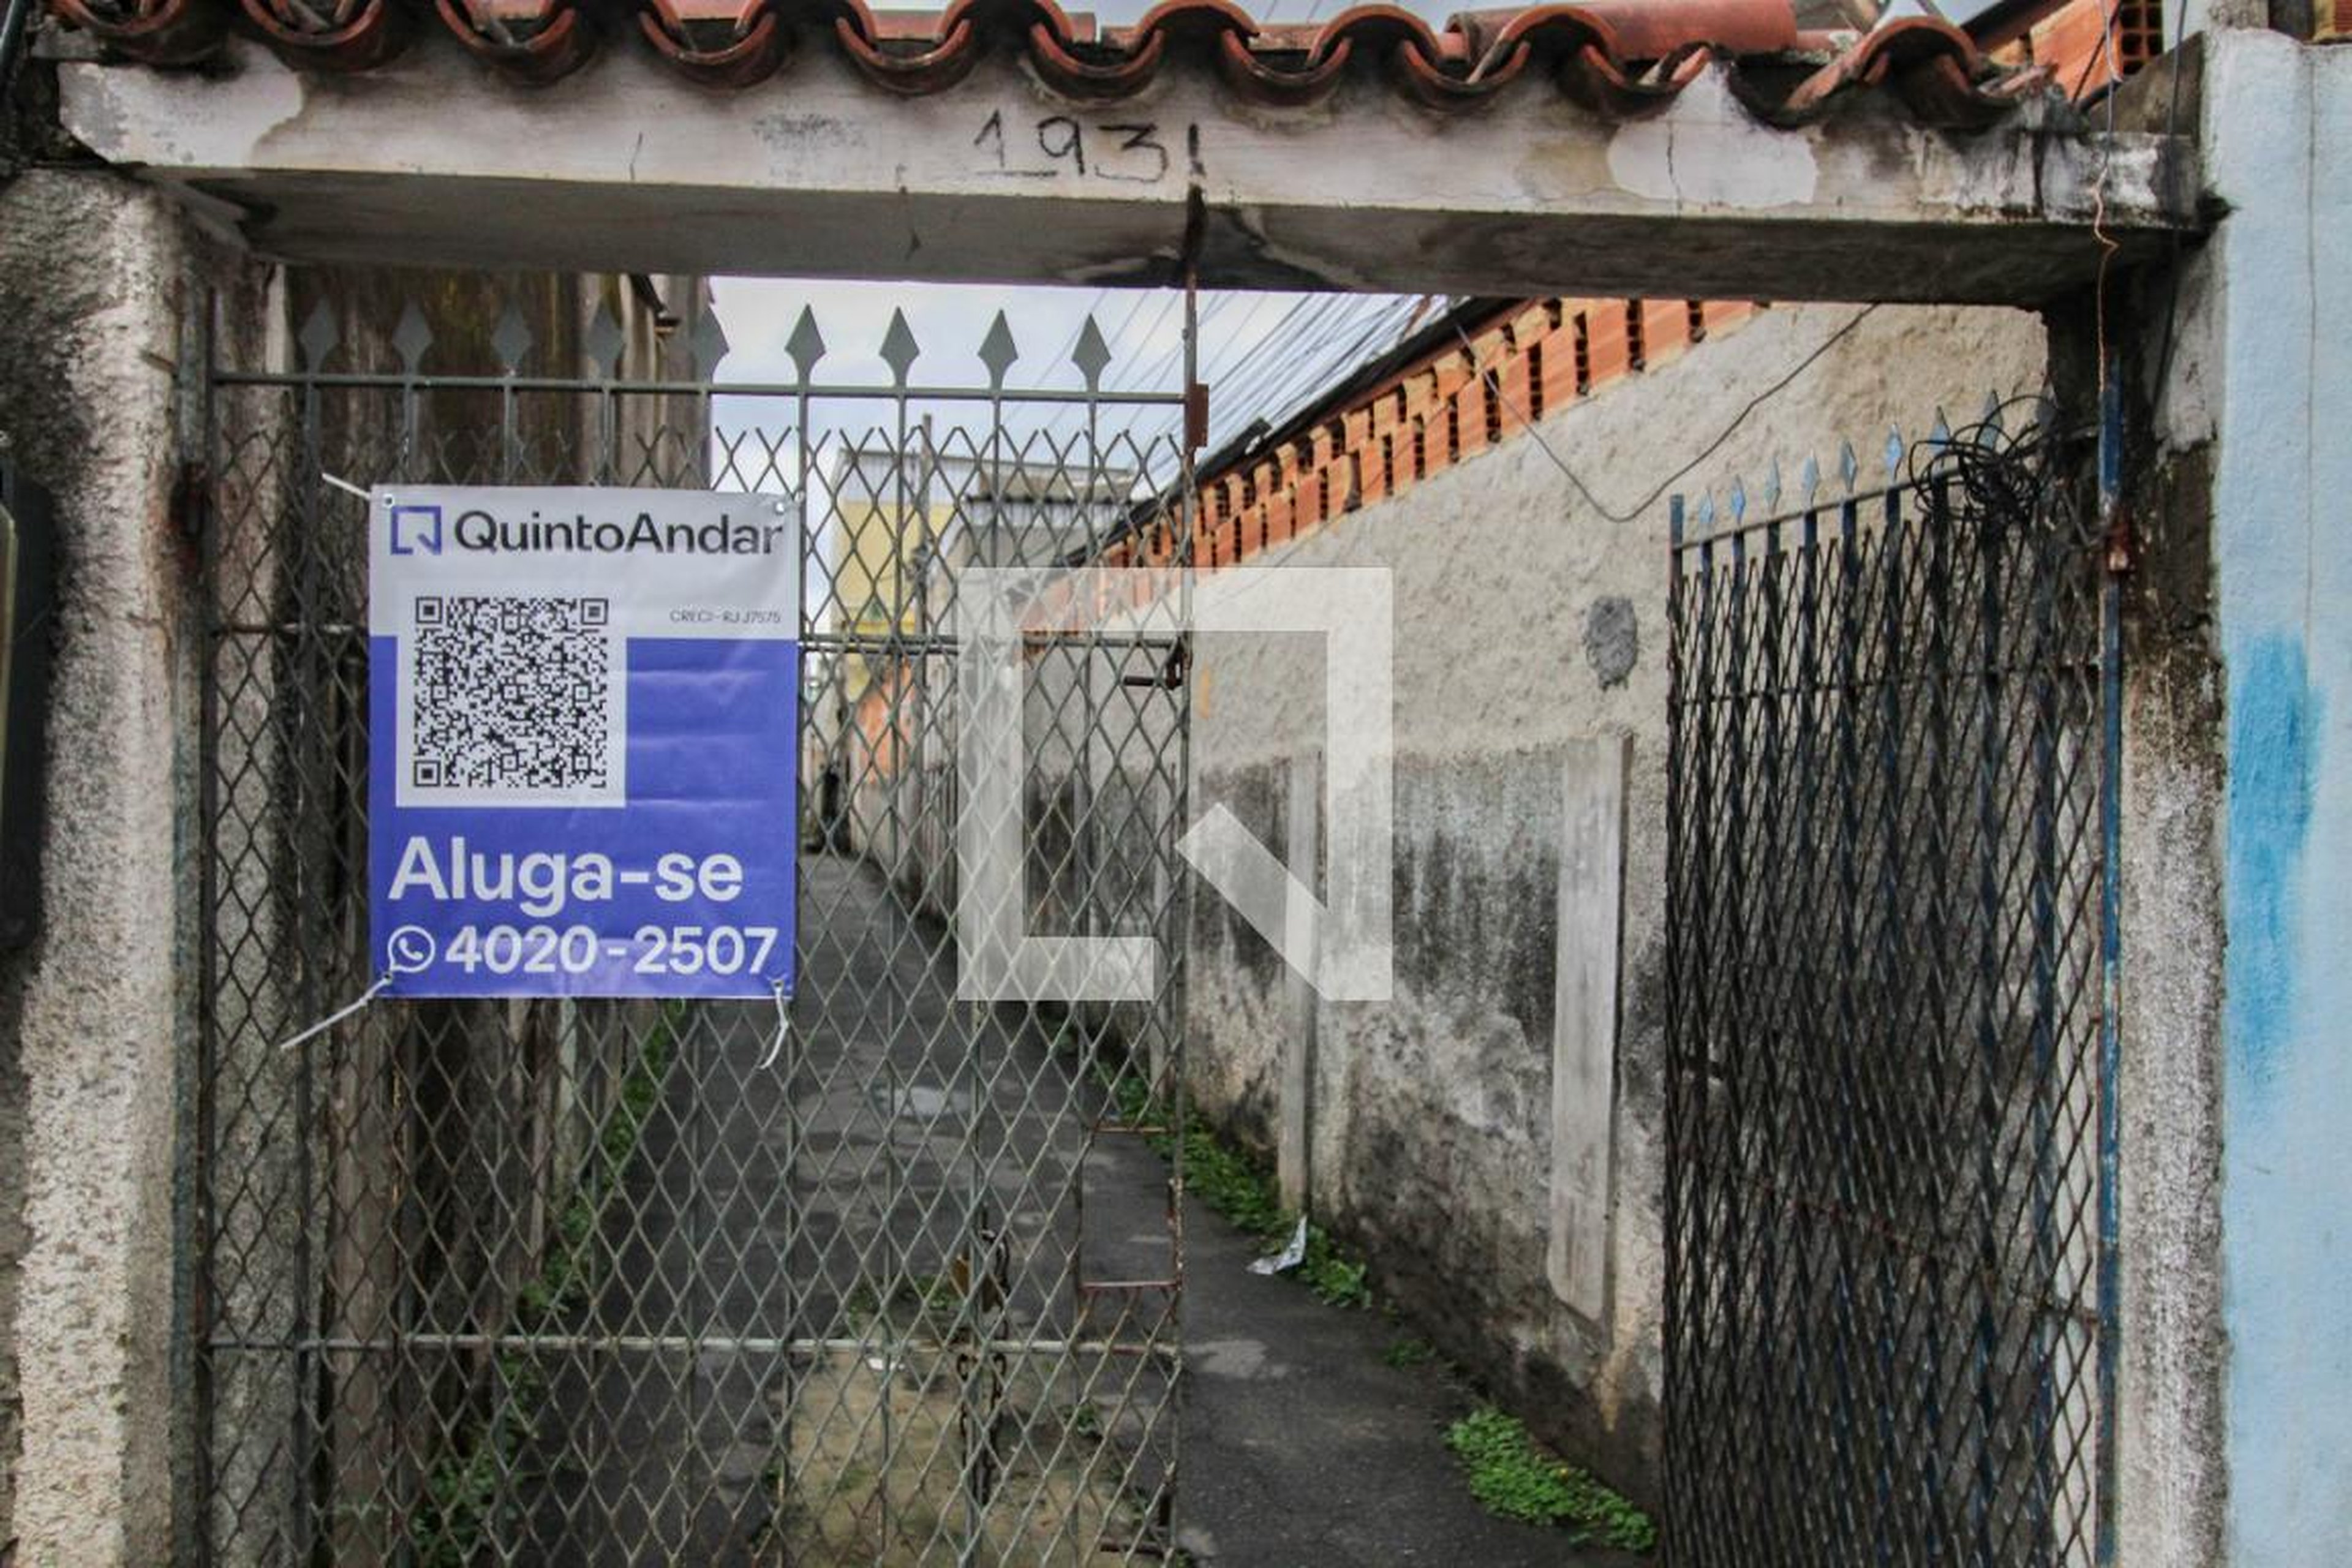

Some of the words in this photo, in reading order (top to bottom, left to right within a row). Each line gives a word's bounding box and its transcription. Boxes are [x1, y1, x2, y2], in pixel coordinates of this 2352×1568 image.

[454, 510, 783, 555] QuintoAndar
[388, 836, 744, 918] Aluga-se
[445, 925, 778, 974] 4020-2507
